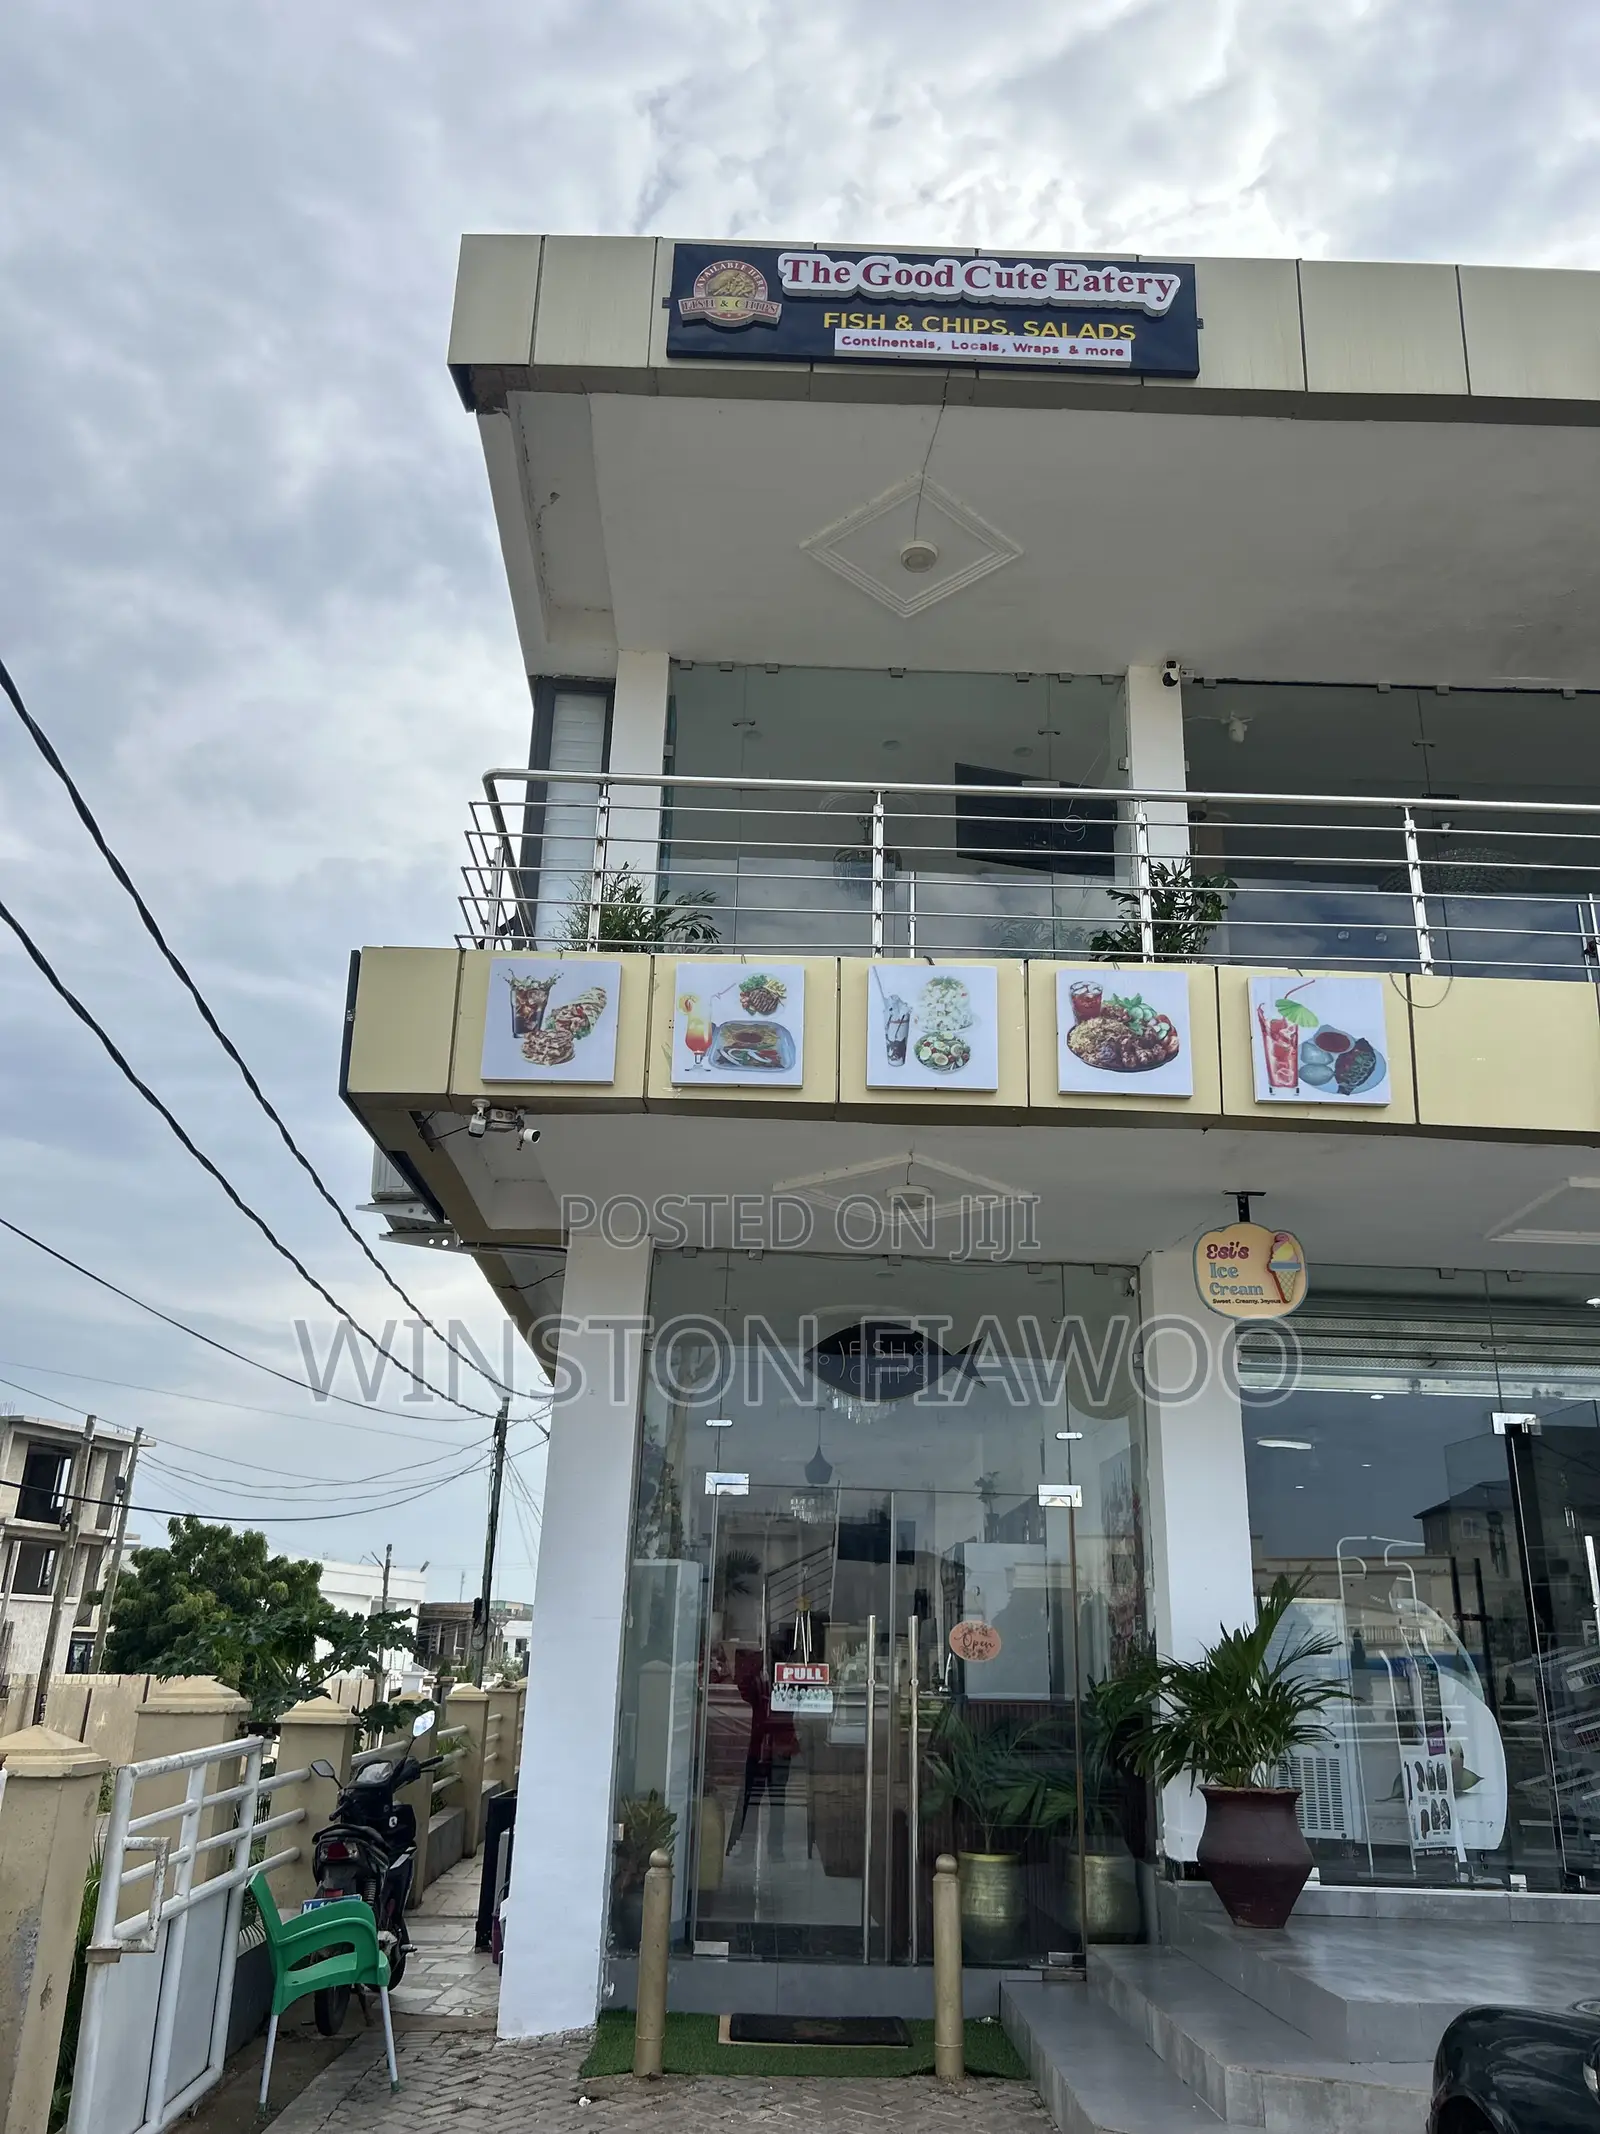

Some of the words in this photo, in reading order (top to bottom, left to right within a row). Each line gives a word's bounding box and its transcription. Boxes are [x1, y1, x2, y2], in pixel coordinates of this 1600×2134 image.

[696, 262, 746, 288] AVAILABLE
[748, 268, 766, 291] HERE
[784, 259, 851, 284] The
[862, 262, 955, 287] Good
[965, 265, 1047, 290] Cute
[1055, 268, 1174, 302] Eatery
[682, 299, 716, 311] FISH
[720, 299, 728, 308] &
[735, 299, 778, 313] CHIPS
[824, 312, 886, 330] FISH
[895, 314, 913, 331] &
[1023, 320, 1136, 341] SALADS
[841, 335, 942, 351] Continentals,
[951, 340, 1006, 353] Locals,
[1013, 342, 1059, 355] Wraps
[1069, 345, 1079, 355] &
[1085, 346, 1124, 356] more
[1206, 1241, 1249, 1259] Esi's
[1209, 1262, 1239, 1278] Ice
[1209, 1282, 1263, 1296] Cream
[849, 1340, 906, 1359] FISH
[914, 1340, 928, 1359] &
[850, 1364, 928, 1385] CHIPS
[954, 1632, 995, 1651] Open
[783, 1667, 823, 1680] PULL
